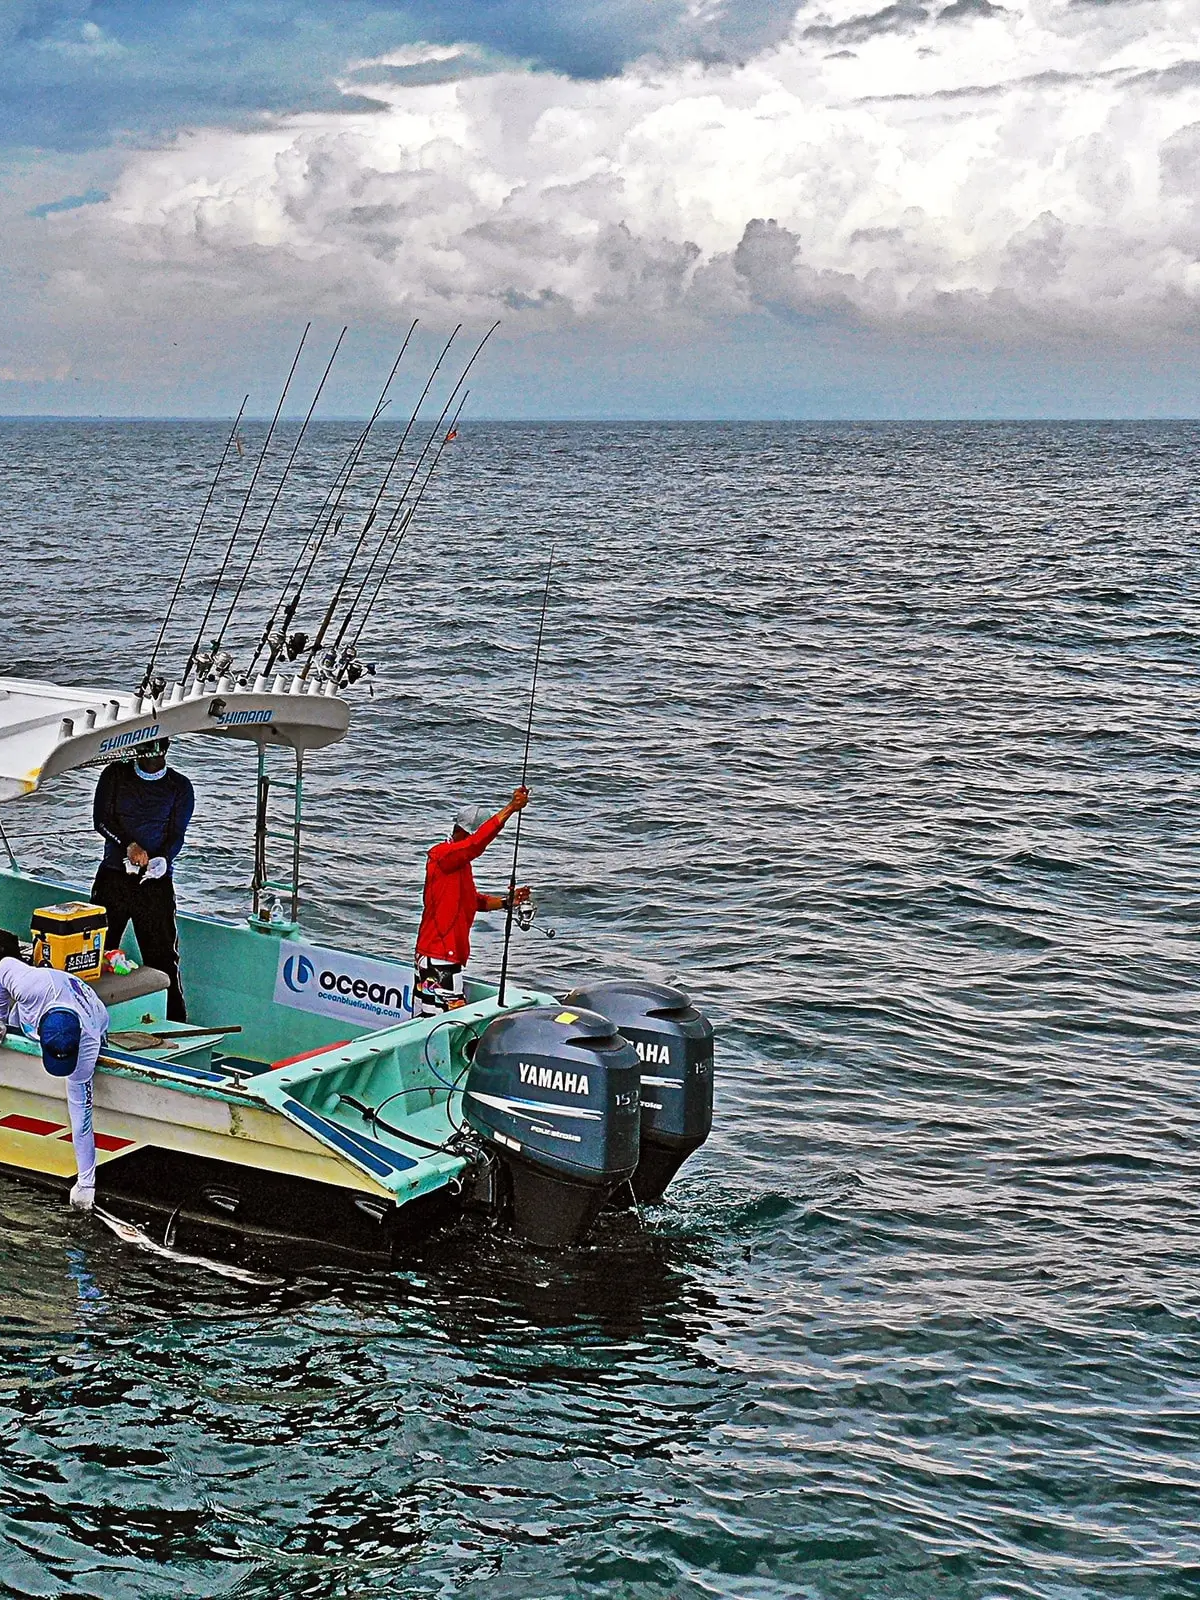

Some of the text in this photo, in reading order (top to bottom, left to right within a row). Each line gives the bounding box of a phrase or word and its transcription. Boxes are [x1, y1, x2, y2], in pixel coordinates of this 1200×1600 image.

[216, 710, 272, 725] SHIMANO
[100, 724, 160, 753] SHIMANO
[318, 992, 401, 1018] oceanbluefishing.com
[519, 1062, 589, 1095] YAMAHA
